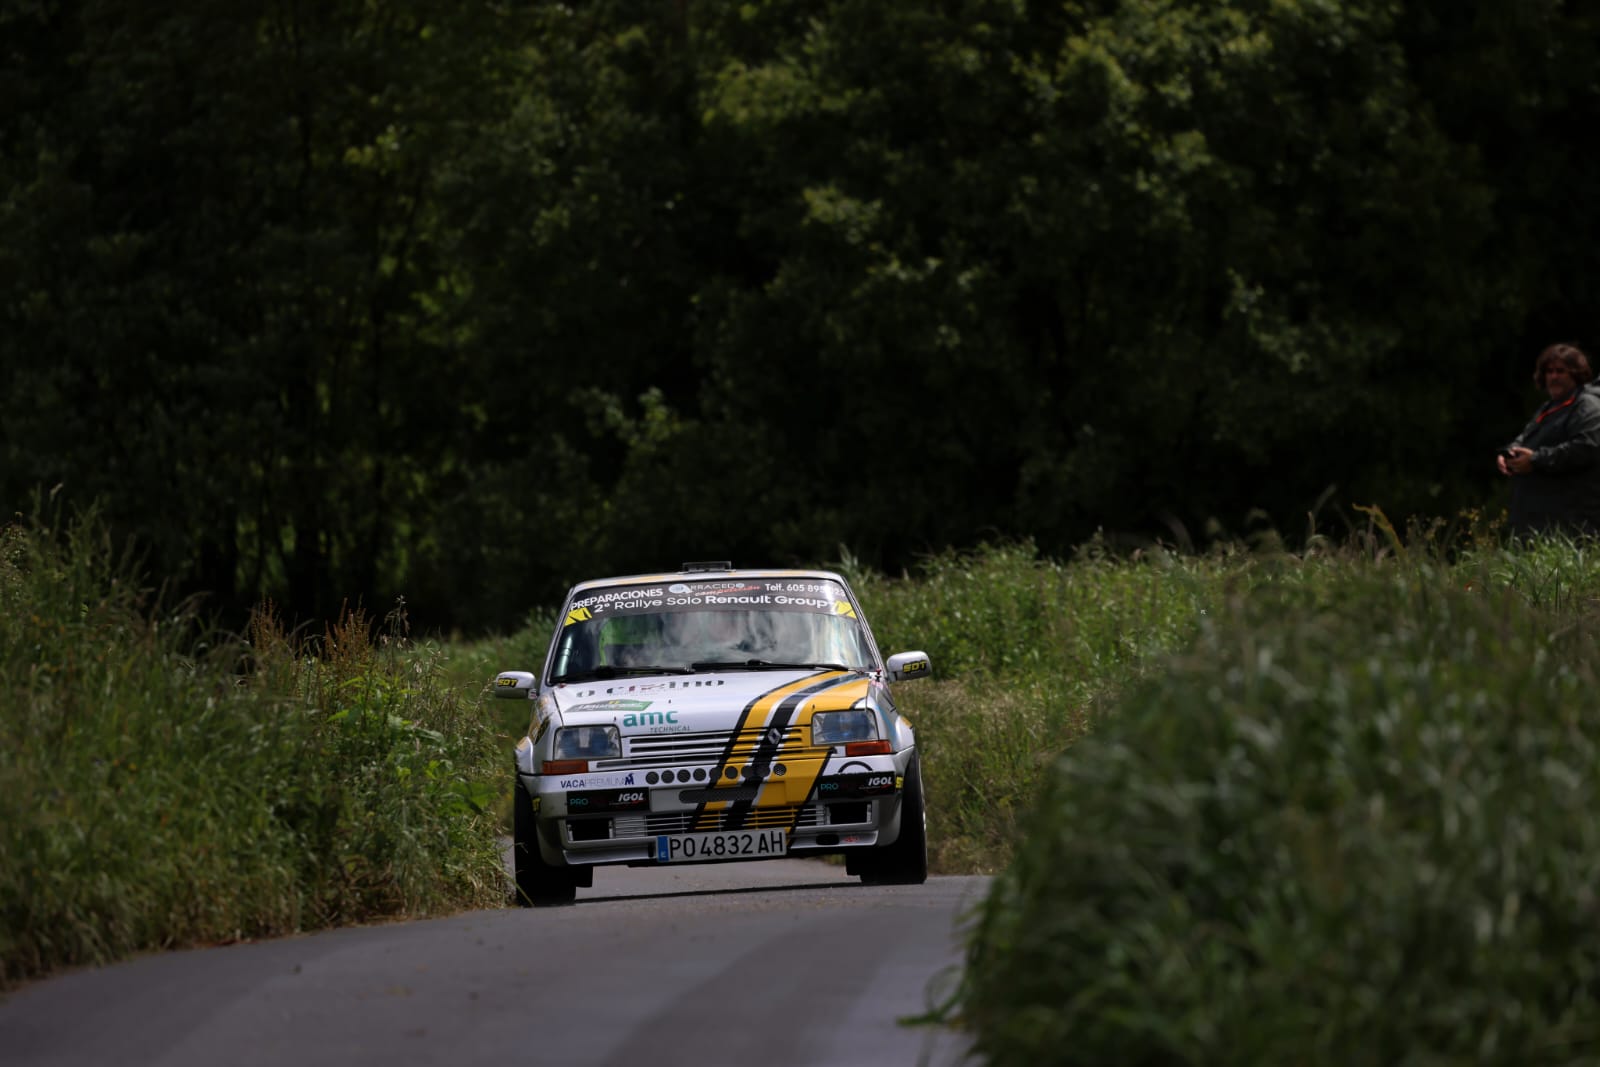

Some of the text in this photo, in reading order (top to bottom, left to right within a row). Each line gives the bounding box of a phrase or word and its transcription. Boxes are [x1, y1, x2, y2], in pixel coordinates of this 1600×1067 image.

[786, 584, 805, 592] 605
[570, 588, 663, 611] PREPARACIONES
[614, 599, 662, 610] Rallye
[666, 595, 701, 606] Solo
[705, 595, 771, 604] Renault
[775, 596, 828, 608] Group
[623, 710, 678, 728] amc
[868, 776, 892, 787] IGOL
[618, 792, 644, 802] IGOL
